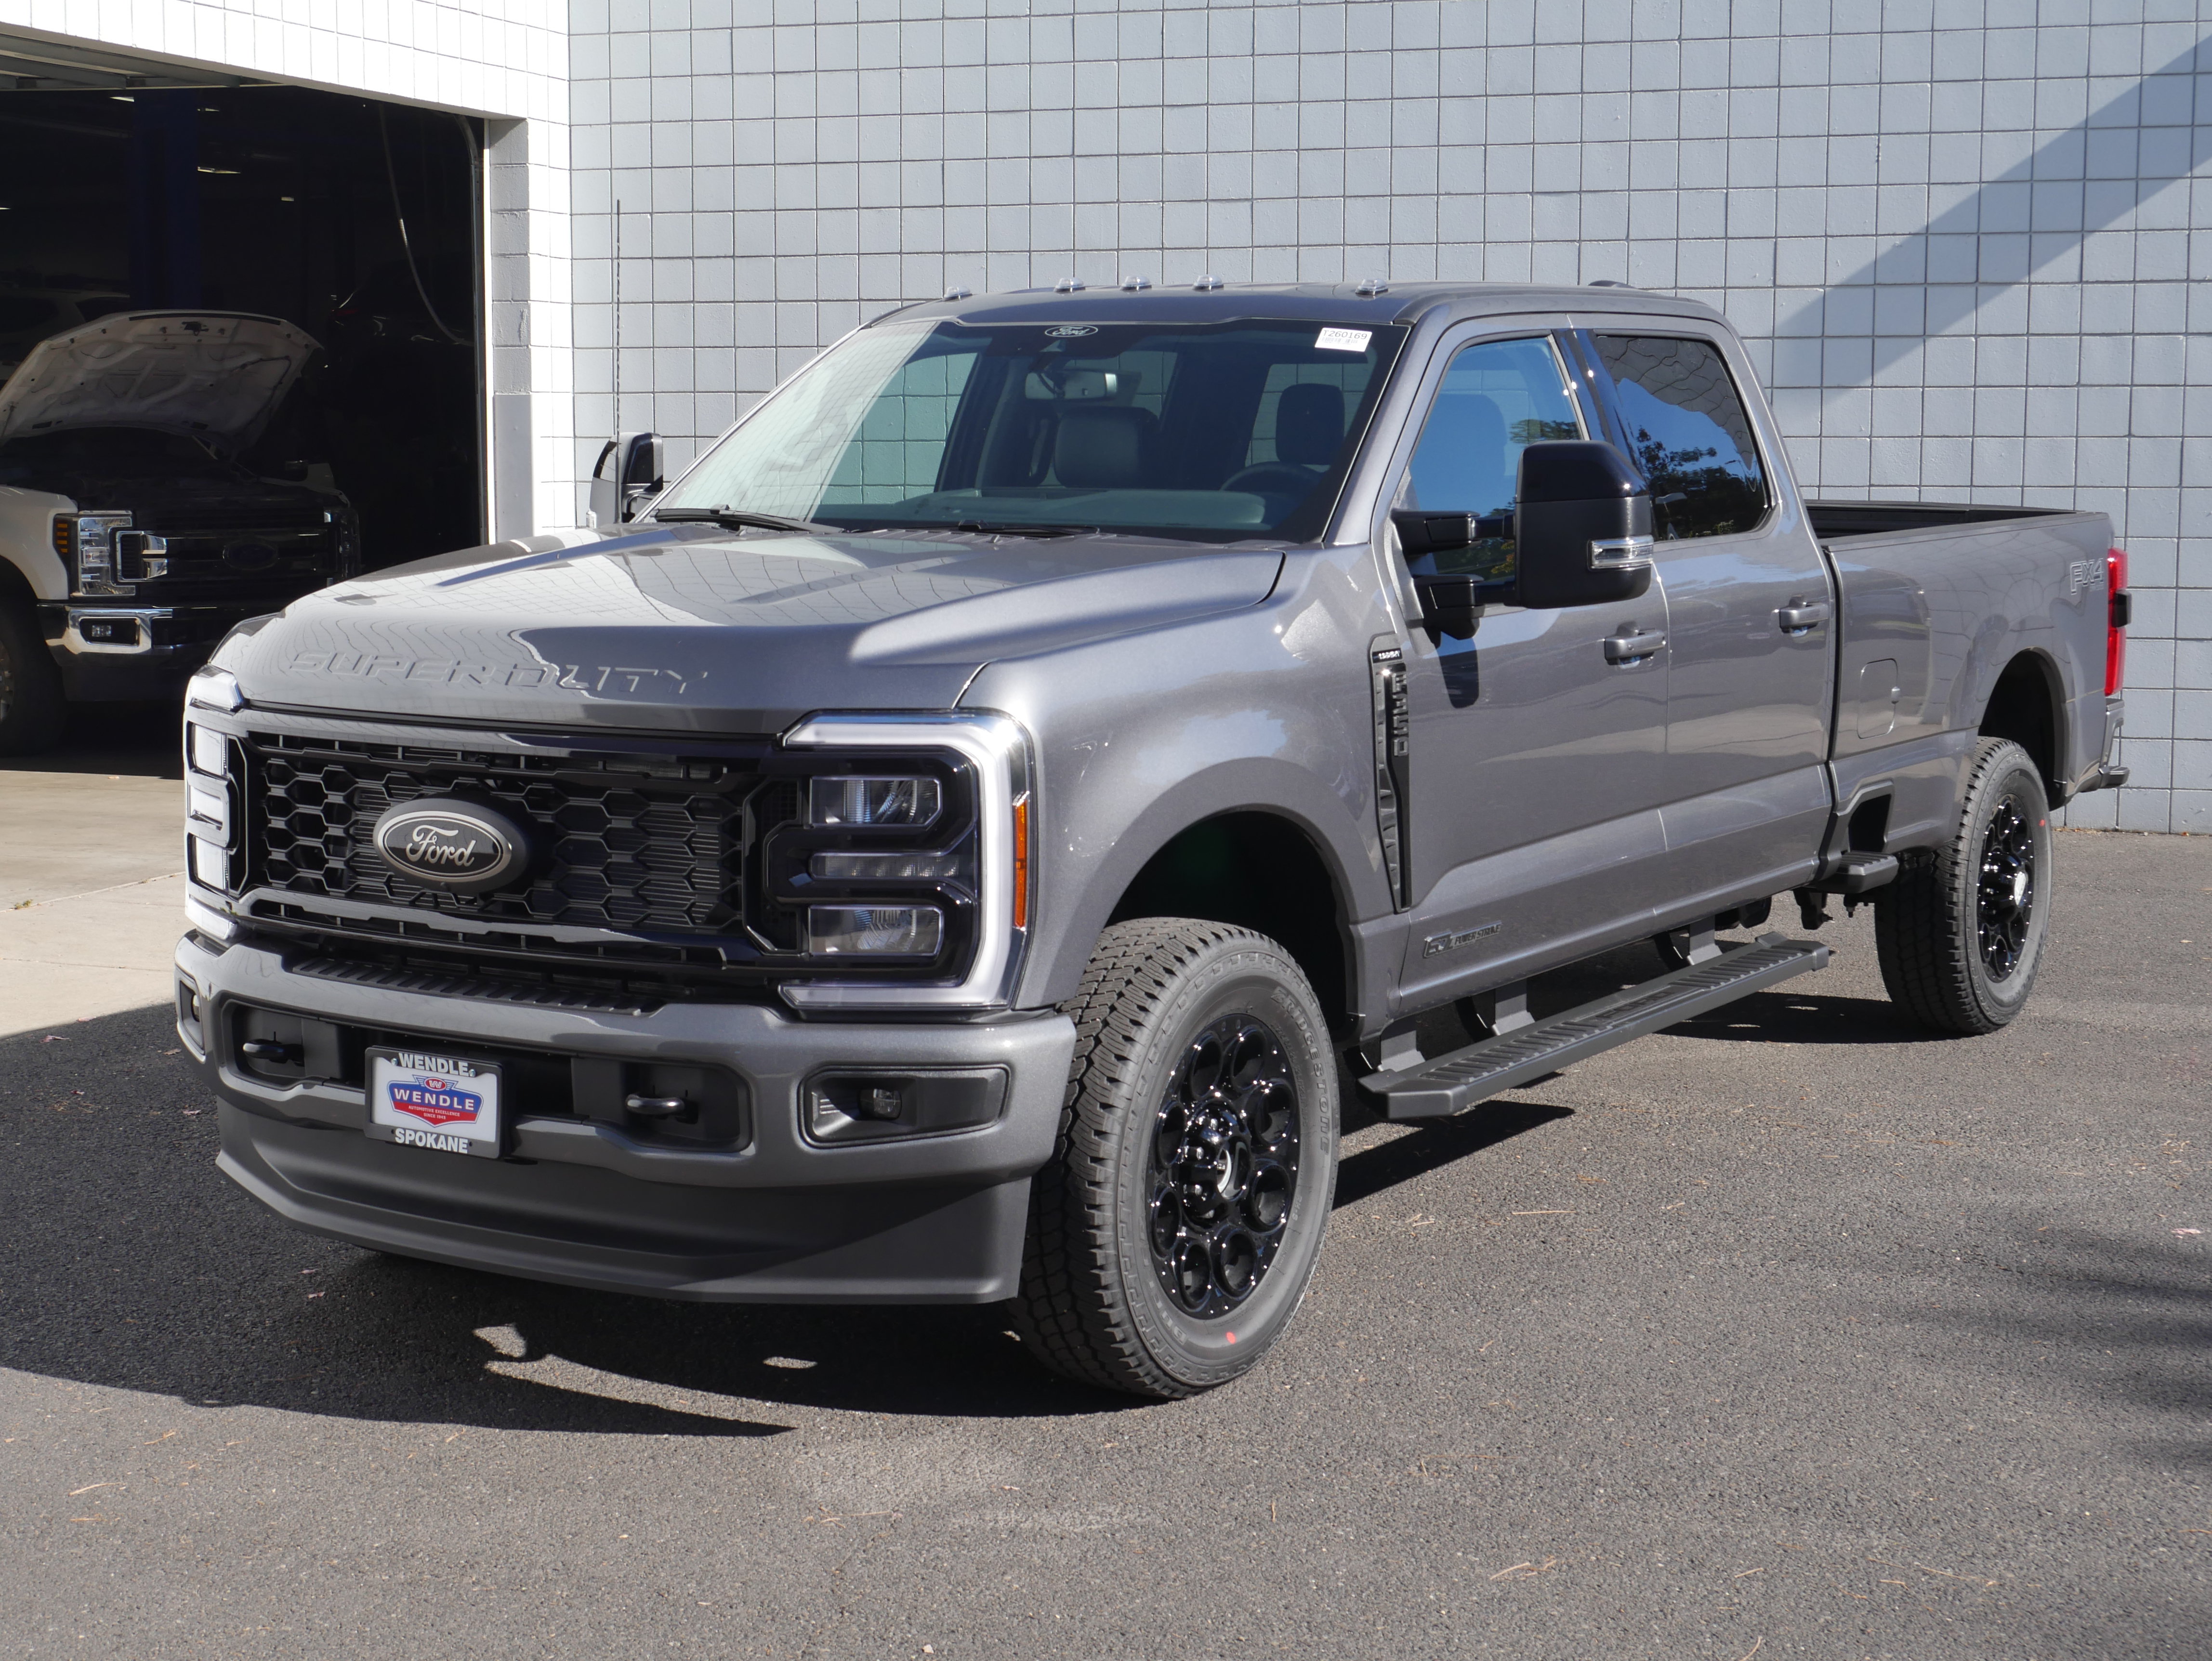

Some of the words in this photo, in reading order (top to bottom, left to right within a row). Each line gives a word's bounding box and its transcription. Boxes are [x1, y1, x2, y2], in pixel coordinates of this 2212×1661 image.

[1052, 326, 1090, 335] Ford
[1323, 330, 1368, 340] T260169
[2070, 557, 2105, 595] FX4
[290, 651, 497, 685] SUPER
[505, 663, 708, 694] DUTY
[1391, 671, 1409, 757] F350
[406, 824, 476, 867] Ford
[398, 1053, 470, 1077] WENDLE
[1270, 987, 1330, 1155] BRIDGESTONE
[394, 1088, 474, 1110] WENDLE
[395, 1128, 468, 1154] SPOKANE
